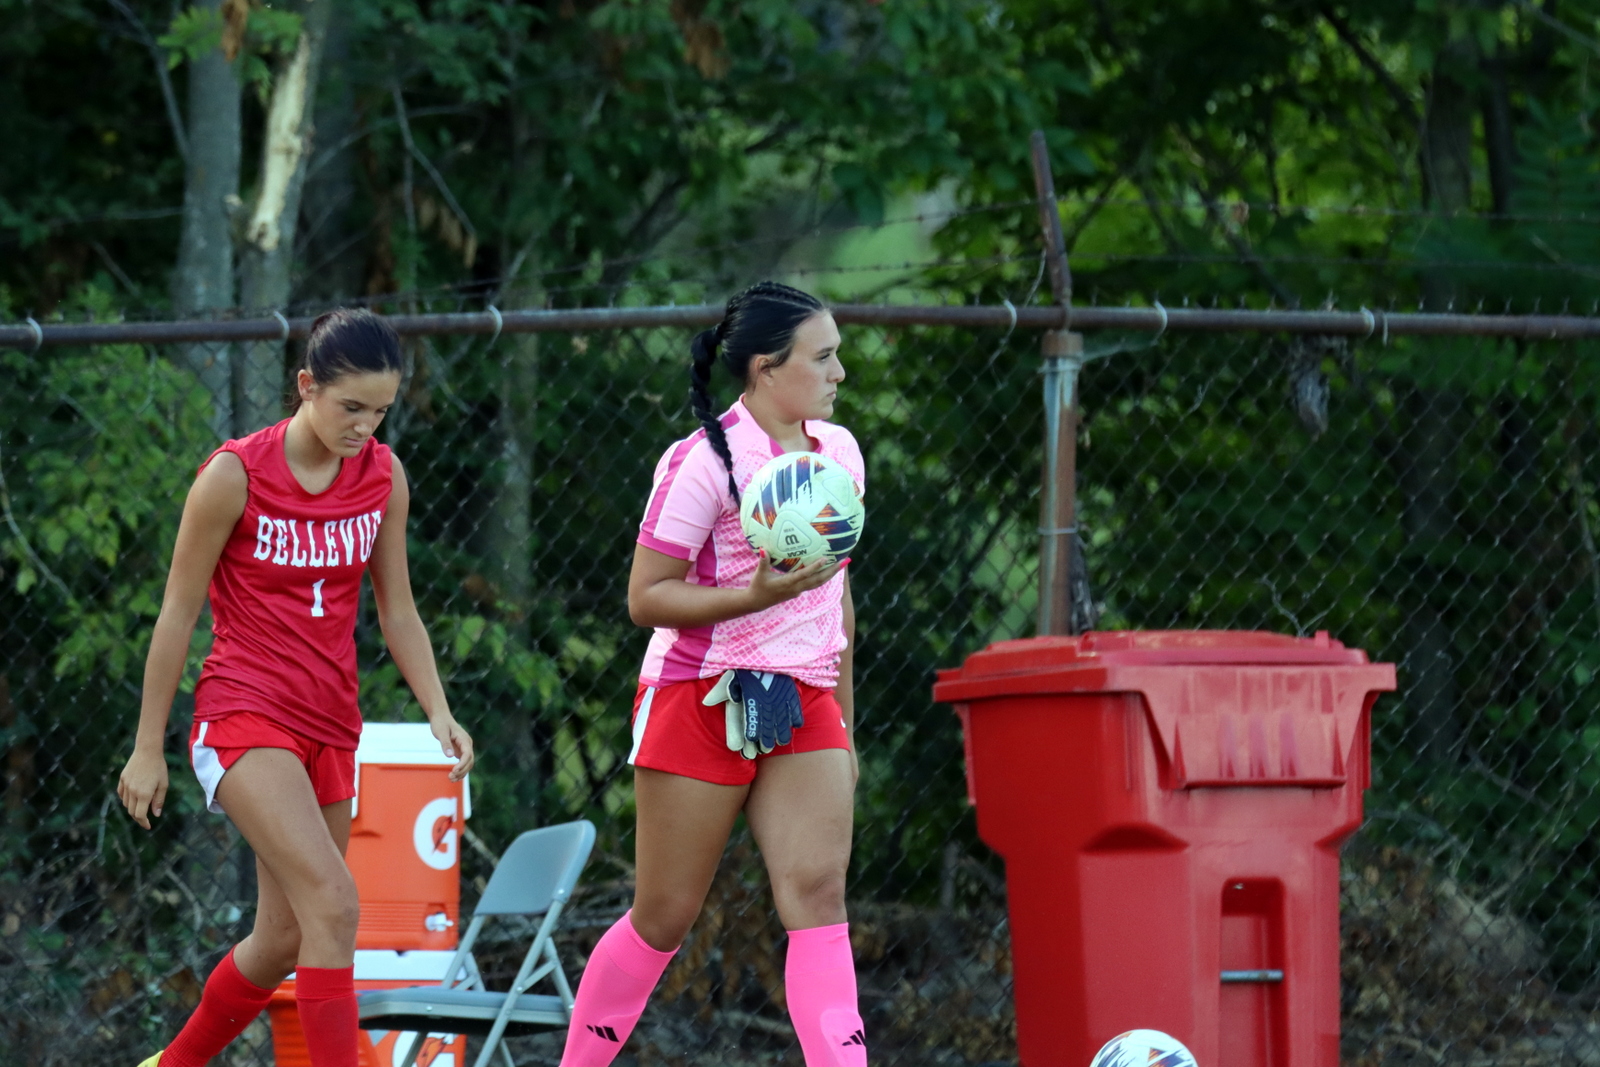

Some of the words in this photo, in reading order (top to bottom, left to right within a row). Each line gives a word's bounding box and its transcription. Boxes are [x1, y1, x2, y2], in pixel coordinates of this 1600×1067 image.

[310, 578, 326, 617] 1
[747, 698, 759, 738] adidas
[413, 796, 458, 871] G
